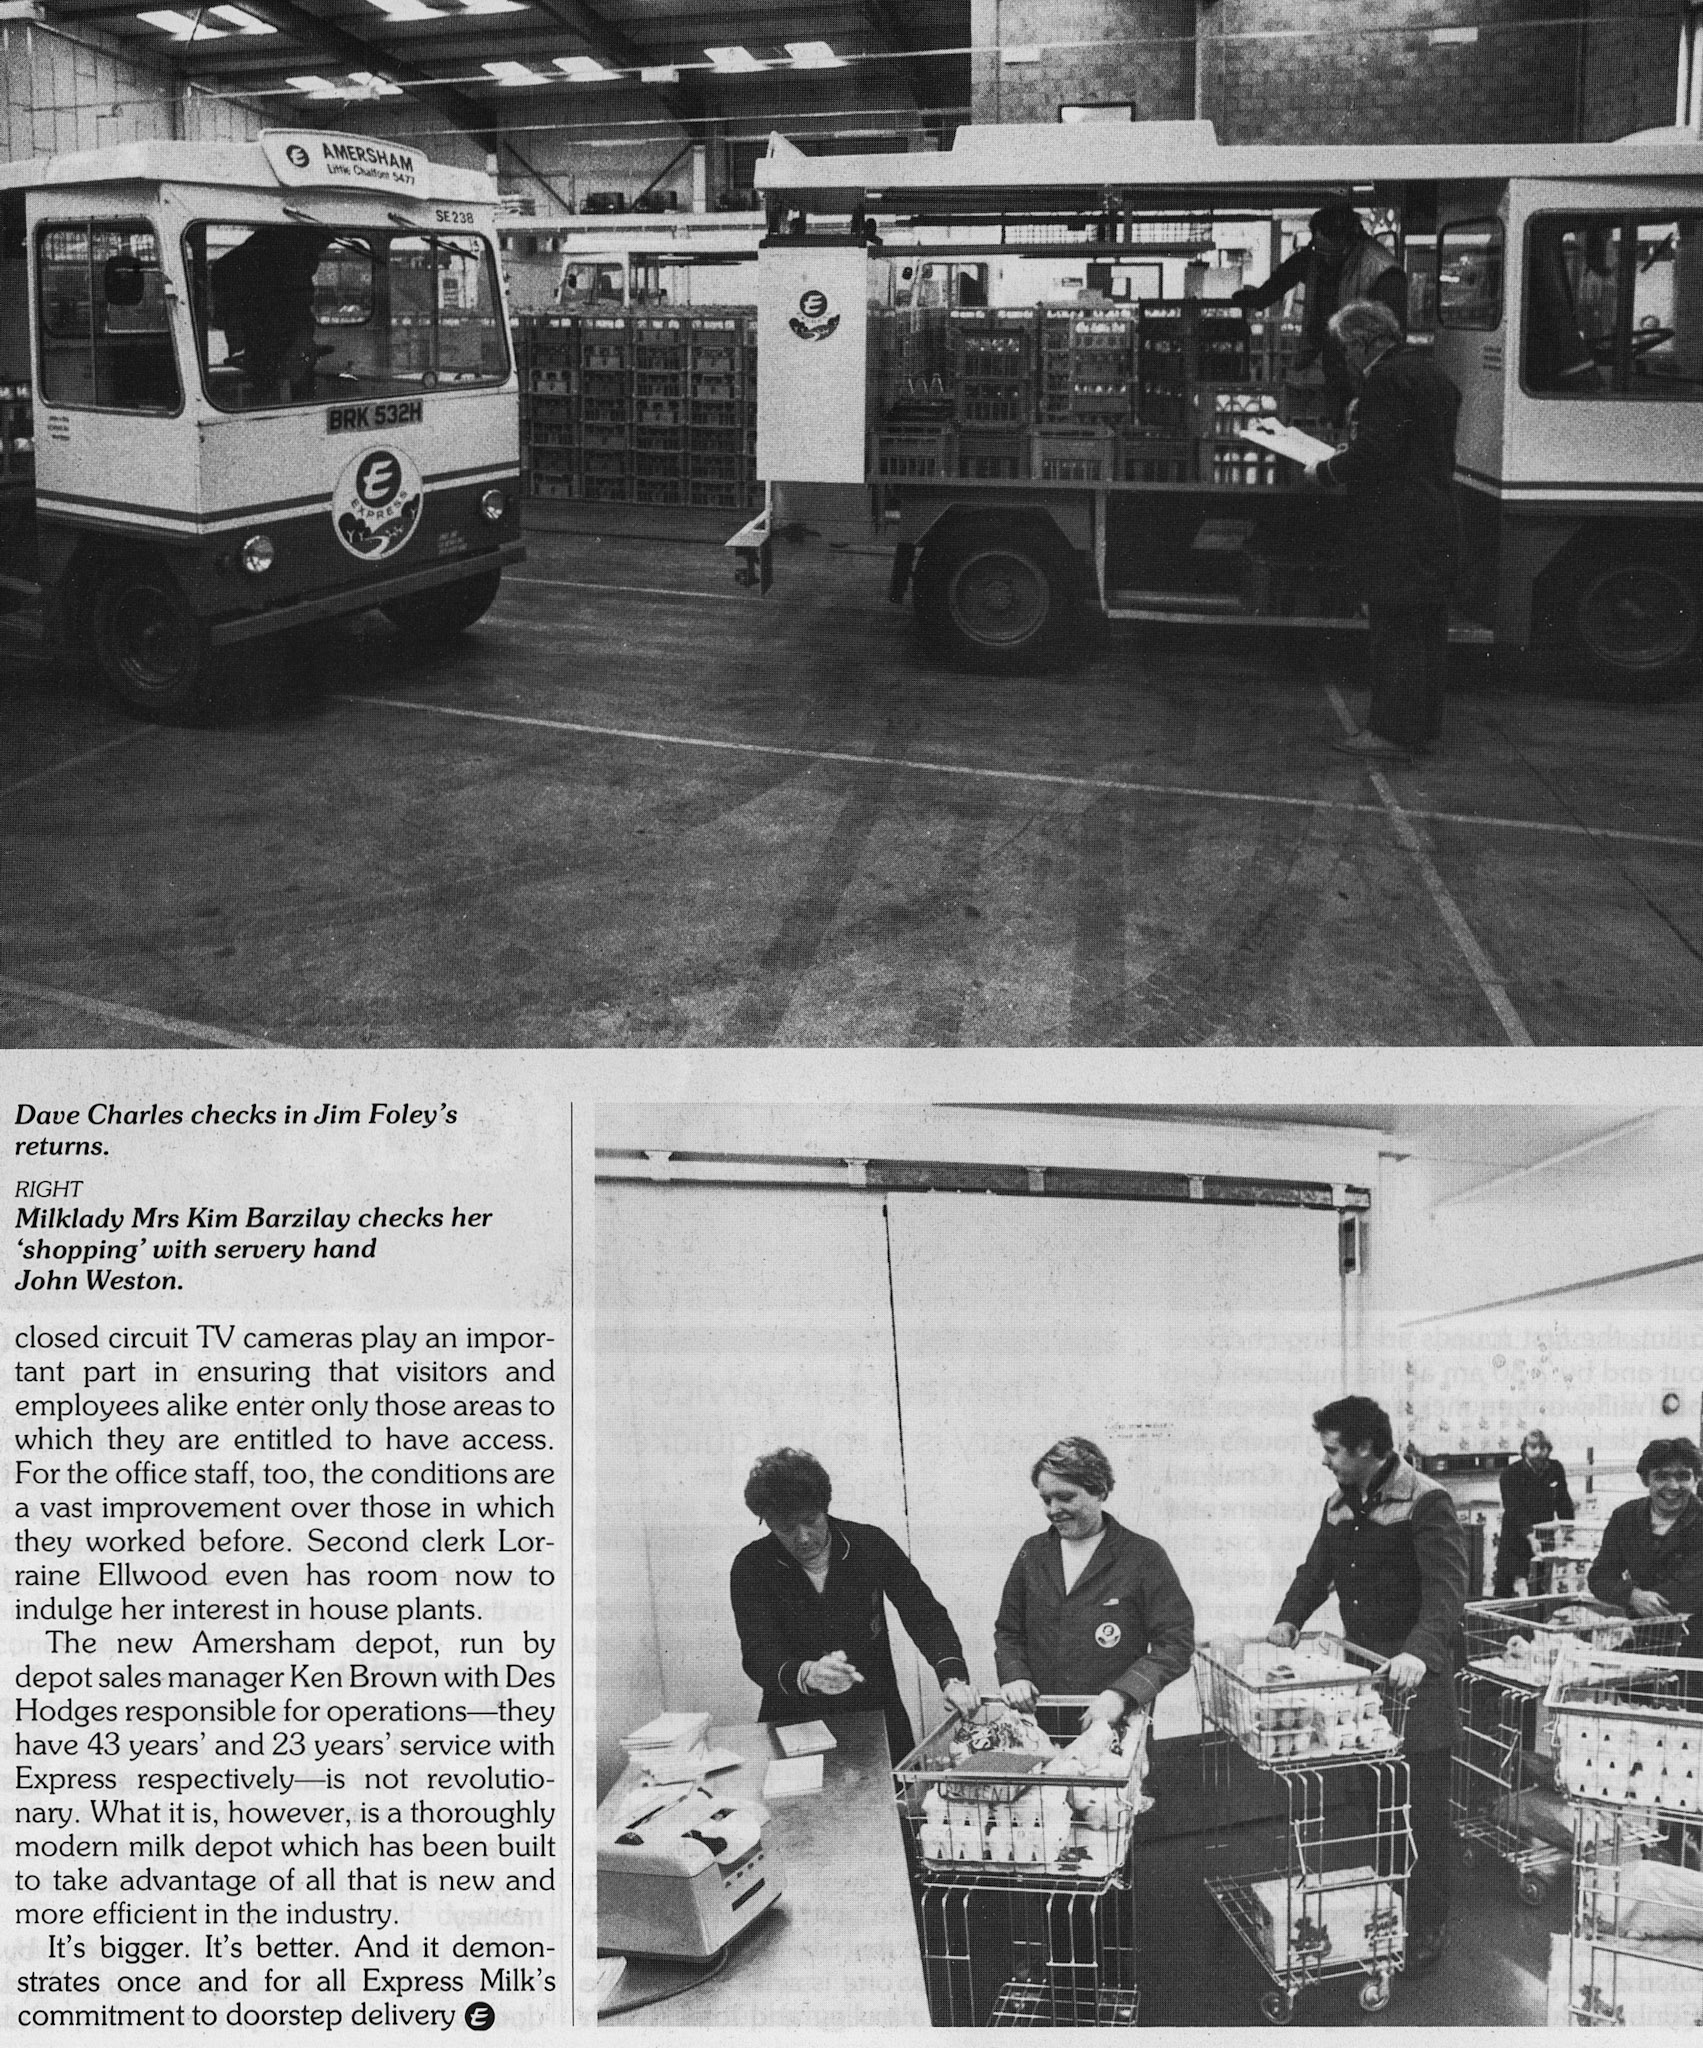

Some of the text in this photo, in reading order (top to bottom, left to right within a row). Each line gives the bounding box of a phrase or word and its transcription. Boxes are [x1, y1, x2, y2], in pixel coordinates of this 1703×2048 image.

[322, 142, 414, 173] AMERSHAM
[326, 163, 416, 186] Little Chalfont 5477
[329, 400, 423, 431] BRK 532H
[351, 490, 409, 520] EXPRESS
[14, 1103, 80, 1125] Dave
[87, 1103, 184, 1125] Charles
[191, 1103, 277, 1125] checks
[284, 1104, 307, 1125] in
[313, 1103, 361, 1125] Jim
[15, 1137, 109, 1156] returns.
[14, 1180, 84, 1198] RIGHT
[14, 1206, 494, 1233] Milklady Mrs Kim Barzilay checks her
[153, 1237, 207, 1259] with
[214, 1244, 306, 1264] servery
[313, 1237, 377, 1259] hand
[14, 1269, 183, 1291] John Weston.
[15, 1324, 555, 1354] closed circuit TV cameras play an impor-
[15, 1358, 555, 1388] tant part in ensuring that visitors and
[14, 1426, 554, 1456] which they are entitled to have access.
[15, 1460, 555, 1488] For the office staff, too, the conditions are
[14, 1528, 554, 1558] they worked before. Second clerk Lor-
[15, 1562, 555, 1586] raine Ellwood even has room now to
[15, 1596, 482, 1626] indulge her interest in house plants.
[45, 1630, 556, 1660] The new Amersham depot, run by
[15, 1664, 556, 1694] depot sales manager Ken Brown with Des
[15, 1697, 118, 1728] Hodges
[125, 1697, 276, 1728] responsible
[283, 1698, 321, 1722] for
[15, 1731, 78, 1756] have
[87, 1731, 120, 1756] 43
[215, 1732, 265, 1756] and
[272, 1731, 306, 1756] 23
[400, 1734, 491, 1756] service
[499, 1731, 555, 1756] with
[15, 1765, 117, 1795] Express
[365, 1768, 409, 1789] not
[427, 1765, 555, 1790] revolutio-
[15, 1799, 556, 1830] nary. What it is, however, is a thoroughly
[14, 1866, 556, 1897] to take advantage of all that is new and
[15, 1900, 399, 1930] more efficient in the industry.
[99, 1934, 190, 1964] bigger.
[256, 1934, 339, 1959] better.
[354, 1934, 410, 1958] And
[423, 1936, 440, 1958] it
[452, 1934, 555, 1958] demon-
[17, 1971, 100, 1993] strates
[117, 1976, 181, 1993] once
[198, 1968, 248, 1992] and
[264, 1968, 301, 1992] for
[316, 1967, 346, 1992] all
[363, 1968, 464, 1998] Express
[18, 2005, 185, 2027] commitment
[191, 2005, 218, 2026] to
[226, 2001, 342, 2032] doorstep
[351, 2001, 456, 2032] delivery
